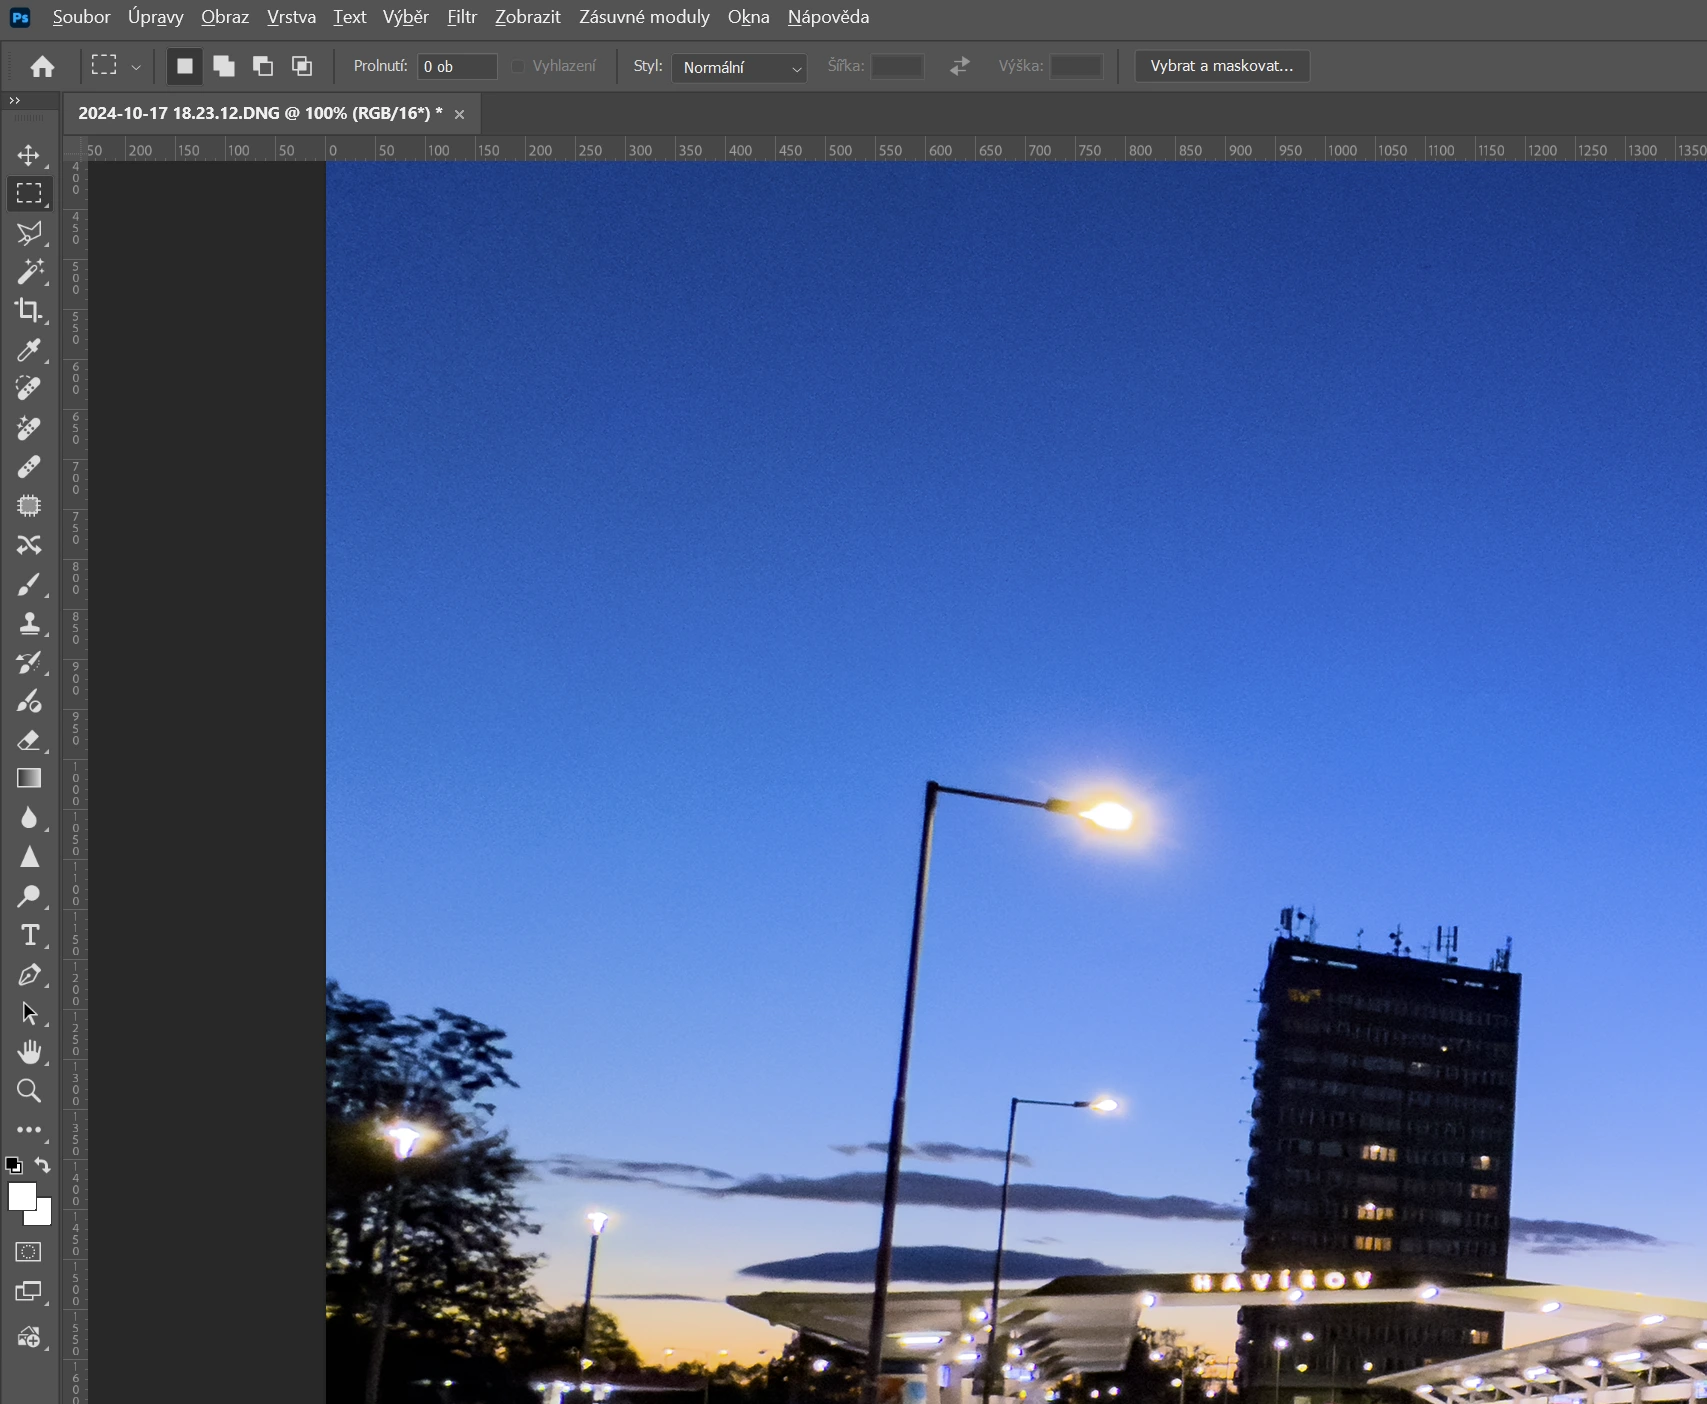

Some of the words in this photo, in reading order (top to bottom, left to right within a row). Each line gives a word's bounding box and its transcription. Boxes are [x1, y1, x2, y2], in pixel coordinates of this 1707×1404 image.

[13, 12, 29, 23] Ps
[53, 9, 111, 26] Soubor
[129, 6, 184, 27] Úpravy
[201, 9, 249, 26] Obraz
[267, 10, 316, 26] Vrstva
[333, 10, 367, 26] Text
[383, 9, 429, 27] Výběr
[447, 9, 478, 26] Filtr
[495, 9, 561, 26] Zobrazit
[580, 10, 645, 23] Zásuvné
[651, 9, 710, 27] moduly
[729, 9, 769, 26] Okna
[788, 9, 869, 27] Nápověda
[355, 59, 407, 71] Prolnutí:
[425, 61, 432, 72] 0
[438, 60, 452, 72] ob
[533, 59, 596, 74] Vyhlazení
[634, 59, 662, 74] Styl:
[685, 61, 745, 73] Normální
[828, 57, 864, 71] Šířka:
[999, 59, 1043, 74] Výška:
[1151, 59, 1195, 74] Vybrat
[1201, 63, 1208, 71] a
[1214, 59, 1292, 71] maskovat...
[79, 107, 168, 119] 2024-10-17
[174, 107, 279, 119] 18.23.12.DNG
[285, 107, 300, 120] @
[306, 107, 347, 119] 100%
[129, 145, 152, 156] 200
[179, 145, 199, 156] 150
[280, 145, 294, 156] 50
[330, 145, 337, 156] 0
[429, 145, 449, 156] 100
[479, 145, 499, 156] 150
[580, 145, 602, 156] 250
[630, 145, 652, 156] 300
[729, 145, 752, 156] 400
[779, 145, 802, 156] 450
[880, 145, 902, 156] 550
[930, 145, 952, 156] 600
[1029, 145, 1051, 156] 700
[1079, 145, 1101, 156] 750
[1180, 145, 1202, 156] 850
[1230, 145, 1252, 156] 900
[1329, 145, 1357, 156] 1000
[1379, 145, 1407, 156] 1050
[1479, 145, 1504, 156] 1150
[1529, 145, 1557, 156] 1200
[1629, 145, 1657, 156] 1300
[1679, 145, 1707, 156] 1350
